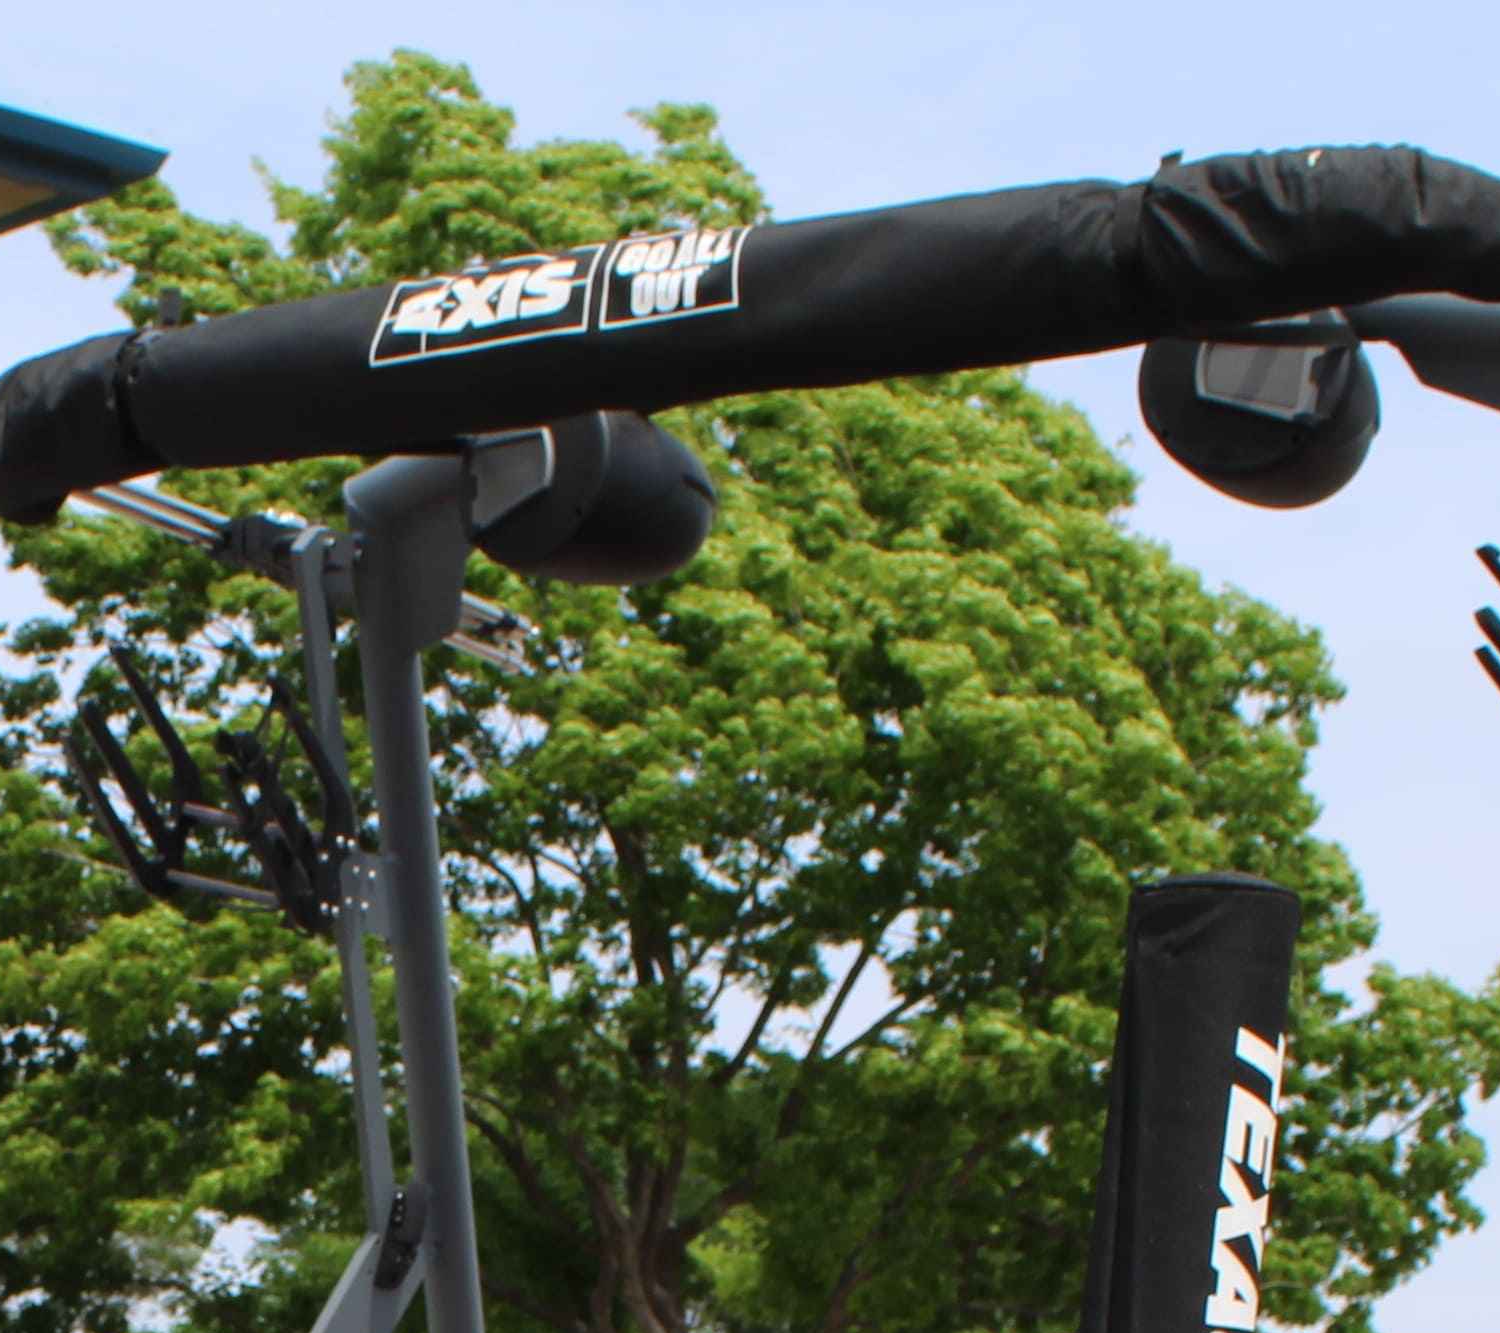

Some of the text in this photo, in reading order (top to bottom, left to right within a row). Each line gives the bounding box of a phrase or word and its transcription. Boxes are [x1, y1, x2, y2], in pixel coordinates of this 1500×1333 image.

[615, 229, 733, 276] GO ALL
[391, 259, 577, 334] AXIS
[630, 263, 712, 317] OUT
